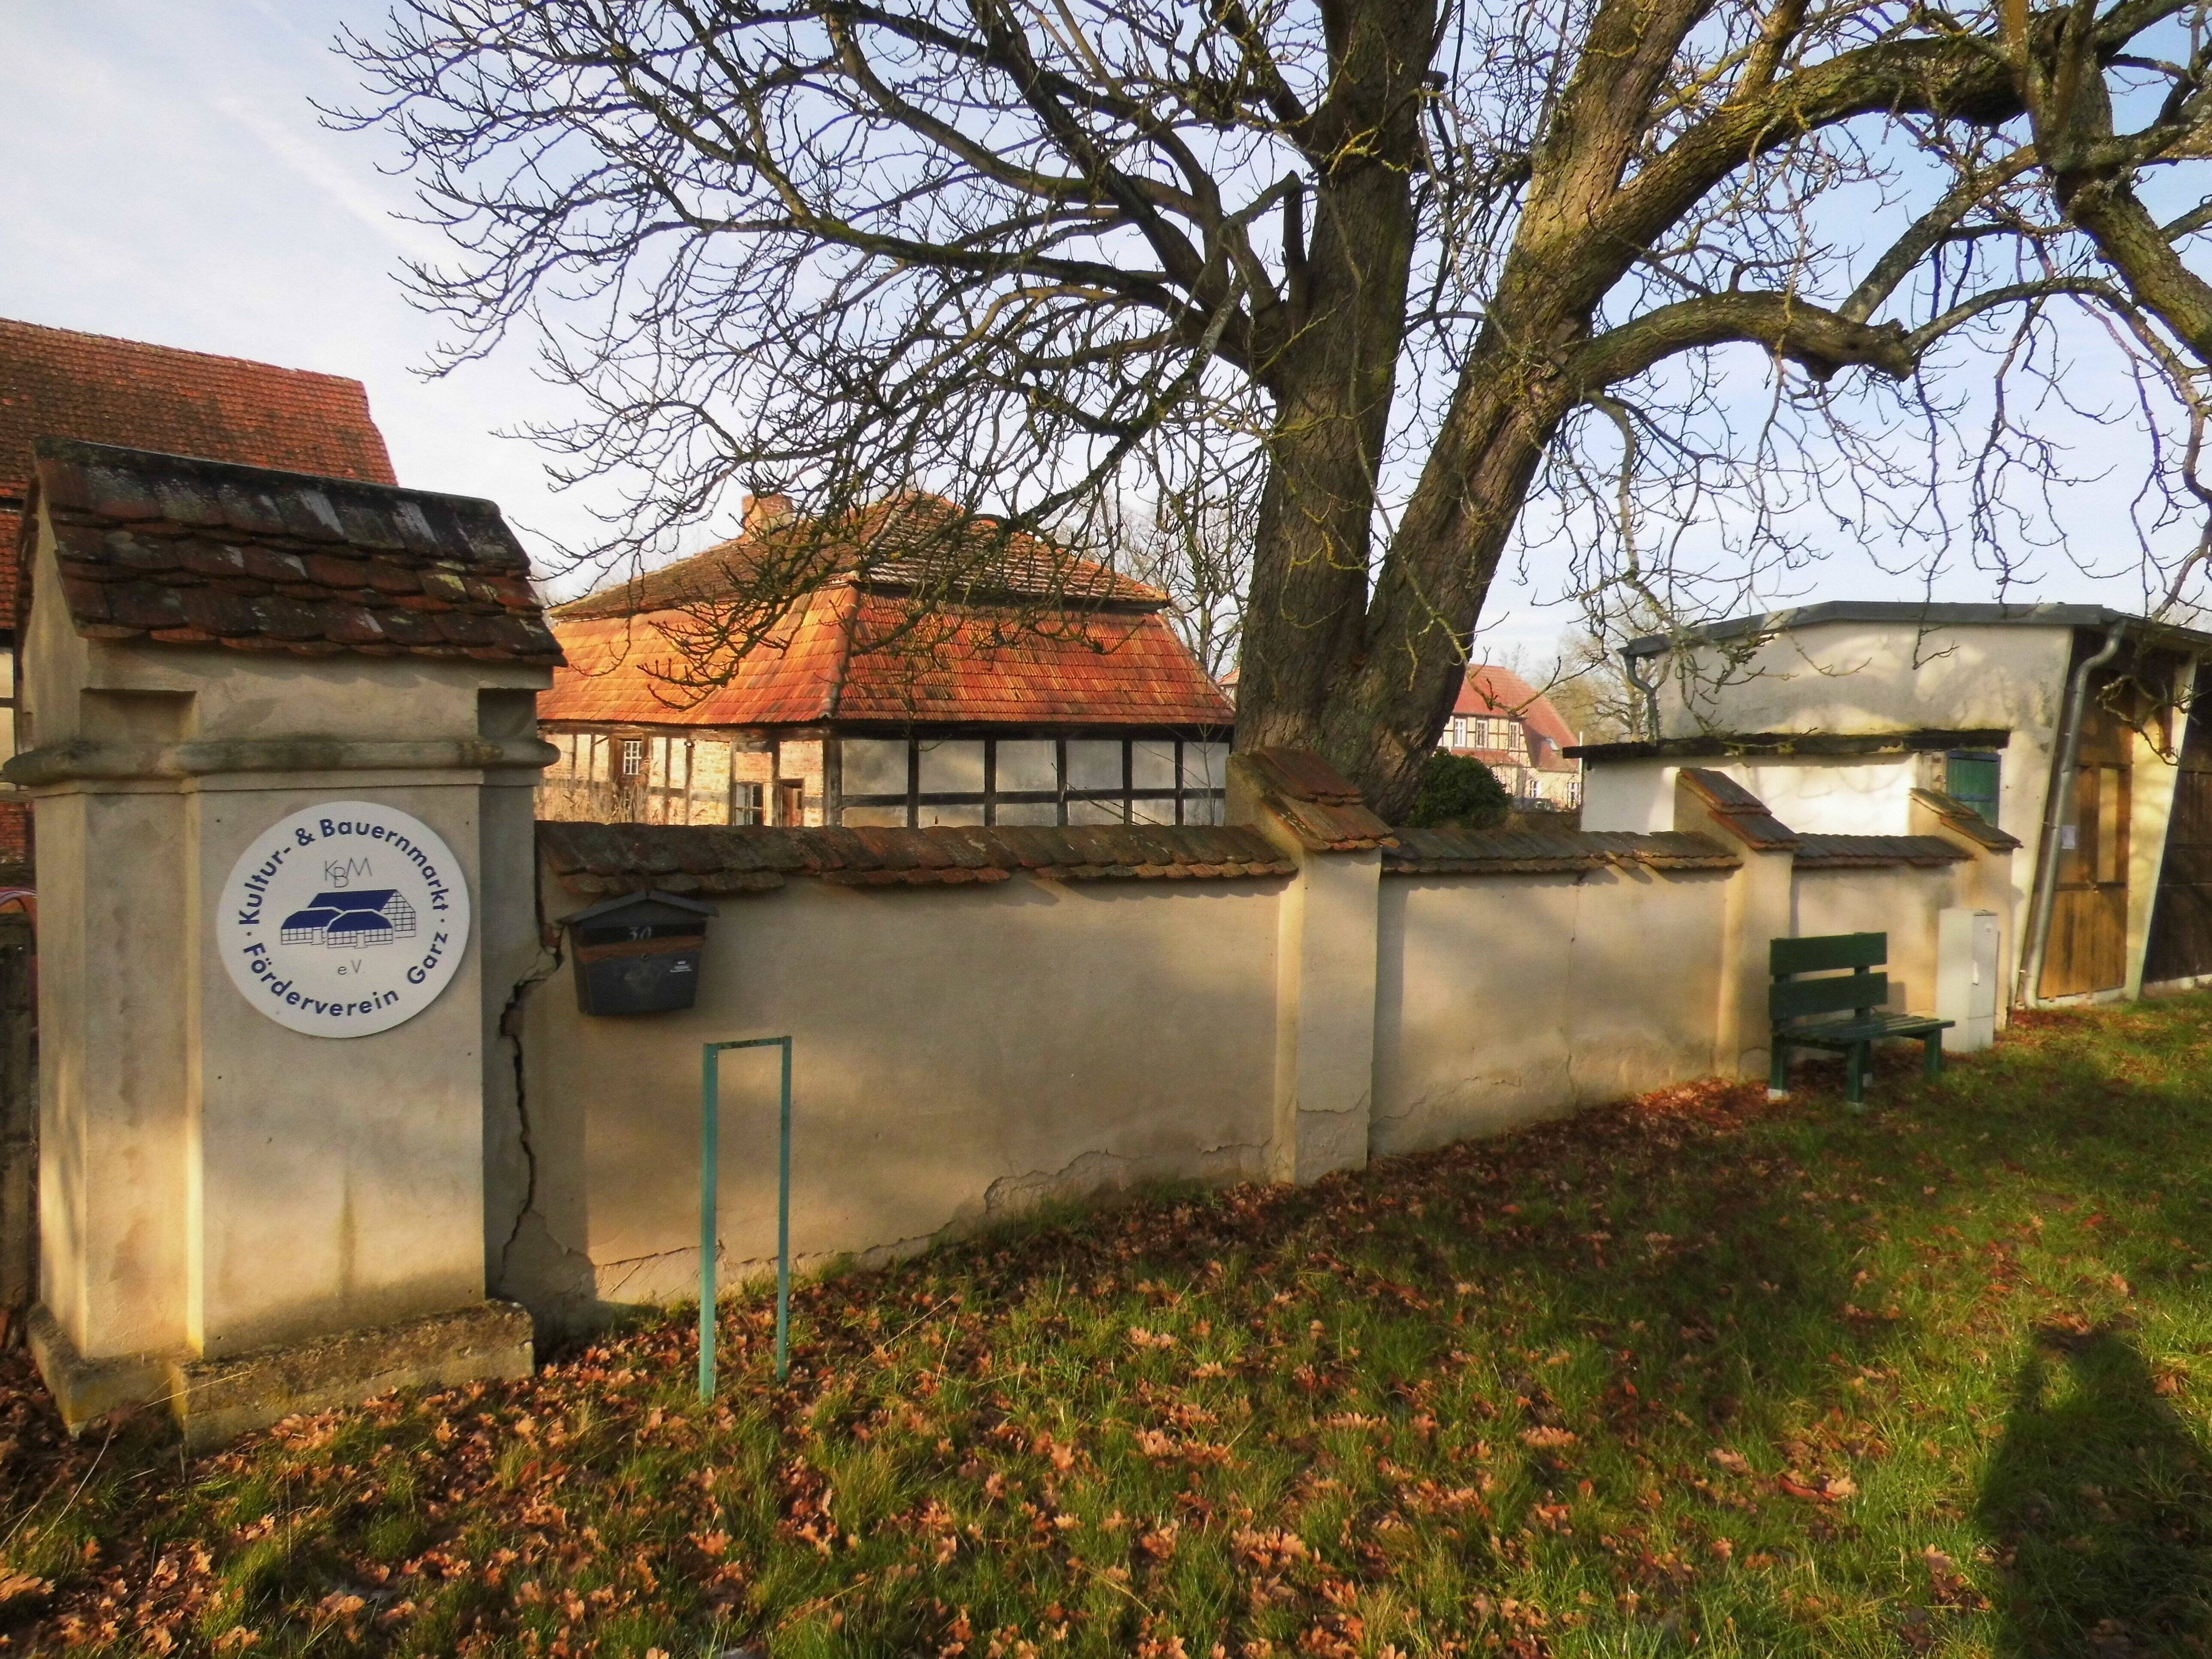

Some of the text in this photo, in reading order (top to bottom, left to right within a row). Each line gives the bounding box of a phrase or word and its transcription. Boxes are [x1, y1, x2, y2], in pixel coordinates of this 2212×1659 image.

[239, 818, 449, 925] Kultur- & Bauernmarkt
[324, 857, 372, 888] KBM
[243, 932, 448, 1017] Förderverein Garz
